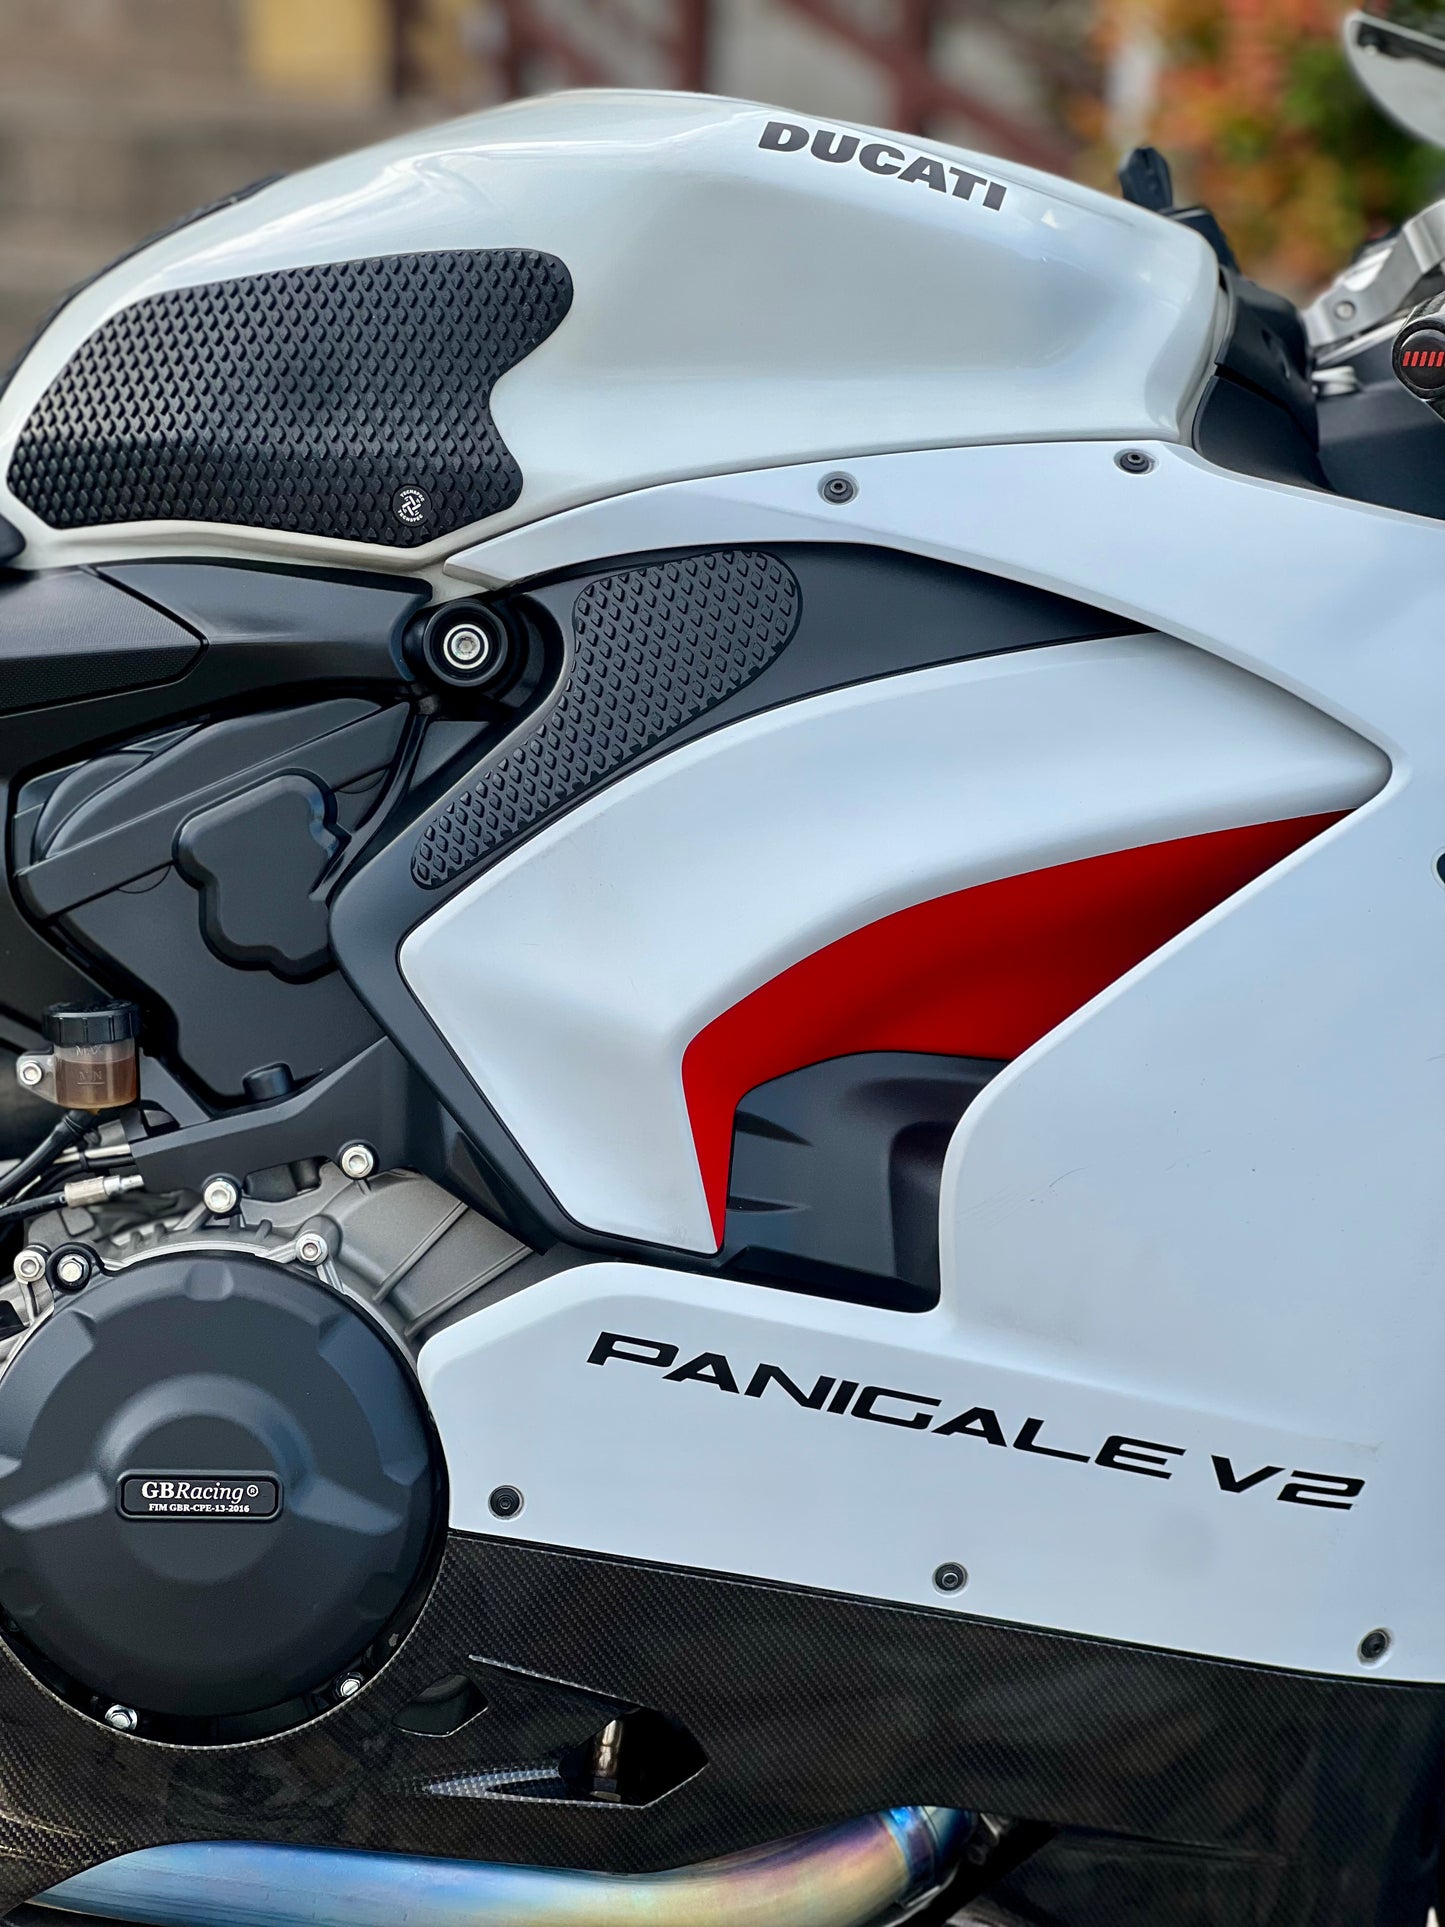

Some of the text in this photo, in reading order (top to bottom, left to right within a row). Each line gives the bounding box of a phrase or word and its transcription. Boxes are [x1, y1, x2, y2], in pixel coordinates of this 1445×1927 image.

[758, 120, 1008, 212] DUCATI
[586, 1331, 1366, 1511] PANIGALE V2
[148, 1503, 250, 1513] FIM GBR-CPE-13-2016
